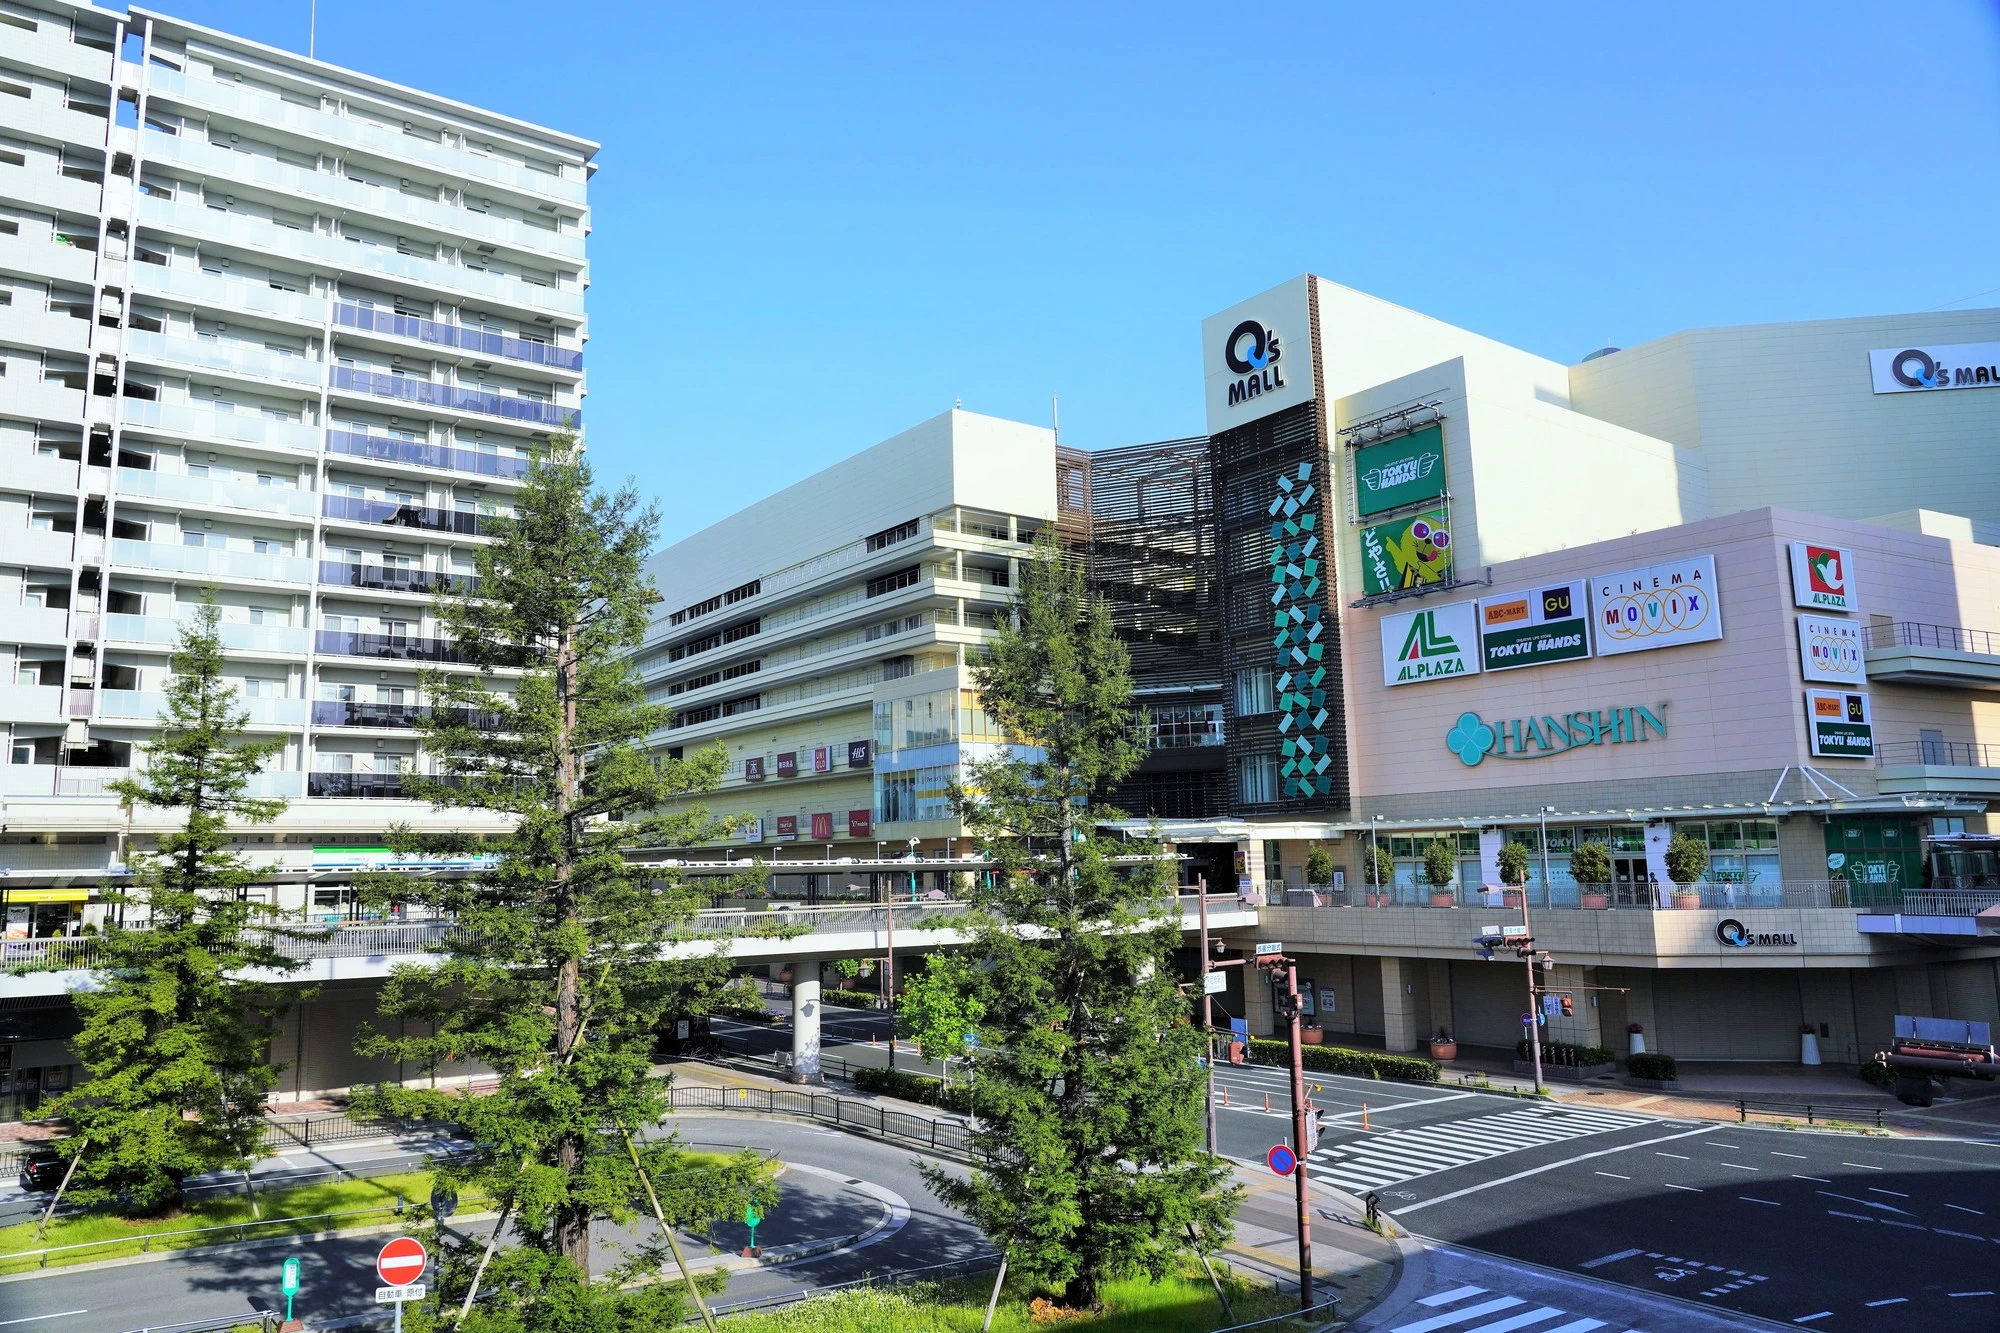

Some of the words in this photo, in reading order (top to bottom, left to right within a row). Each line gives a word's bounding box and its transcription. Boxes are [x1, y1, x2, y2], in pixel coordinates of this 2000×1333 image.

[1225, 320, 1282, 375] Q's
[1892, 349, 1950, 388] Q's
[1228, 365, 1285, 406] MALL
[1381, 460, 1418, 479] TOKYU
[1380, 471, 1417, 489] HANDS
[1602, 569, 1702, 597] CINEMA
[1545, 595, 1569, 611] GU
[1812, 593, 1847, 607] AL.PLAZA
[1488, 606, 1525, 620] ABC-MART
[1605, 595, 1700, 625] MOVIX
[1809, 624, 1856, 637] CINEMA
[1489, 642, 1532, 658] TOKYU
[1537, 634, 1581, 651] HANDS
[1812, 645, 1857, 661] MOVIX
[1397, 657, 1465, 681] AL.PLAZA
[1816, 702, 1840, 711] ABC-MART
[1848, 702, 1862, 715] GU
[1493, 703, 1668, 756] HANSHIN
[1819, 735, 1845, 746] TOKYU
[1847, 736, 1871, 747] HANDS
[816, 751, 825, 759] UNI
[816, 760, 825, 769] QLO
[1716, 871, 1744, 879] TOKYU
[1716, 918, 1755, 947] Q's
[1758, 933, 1797, 946] MALL
